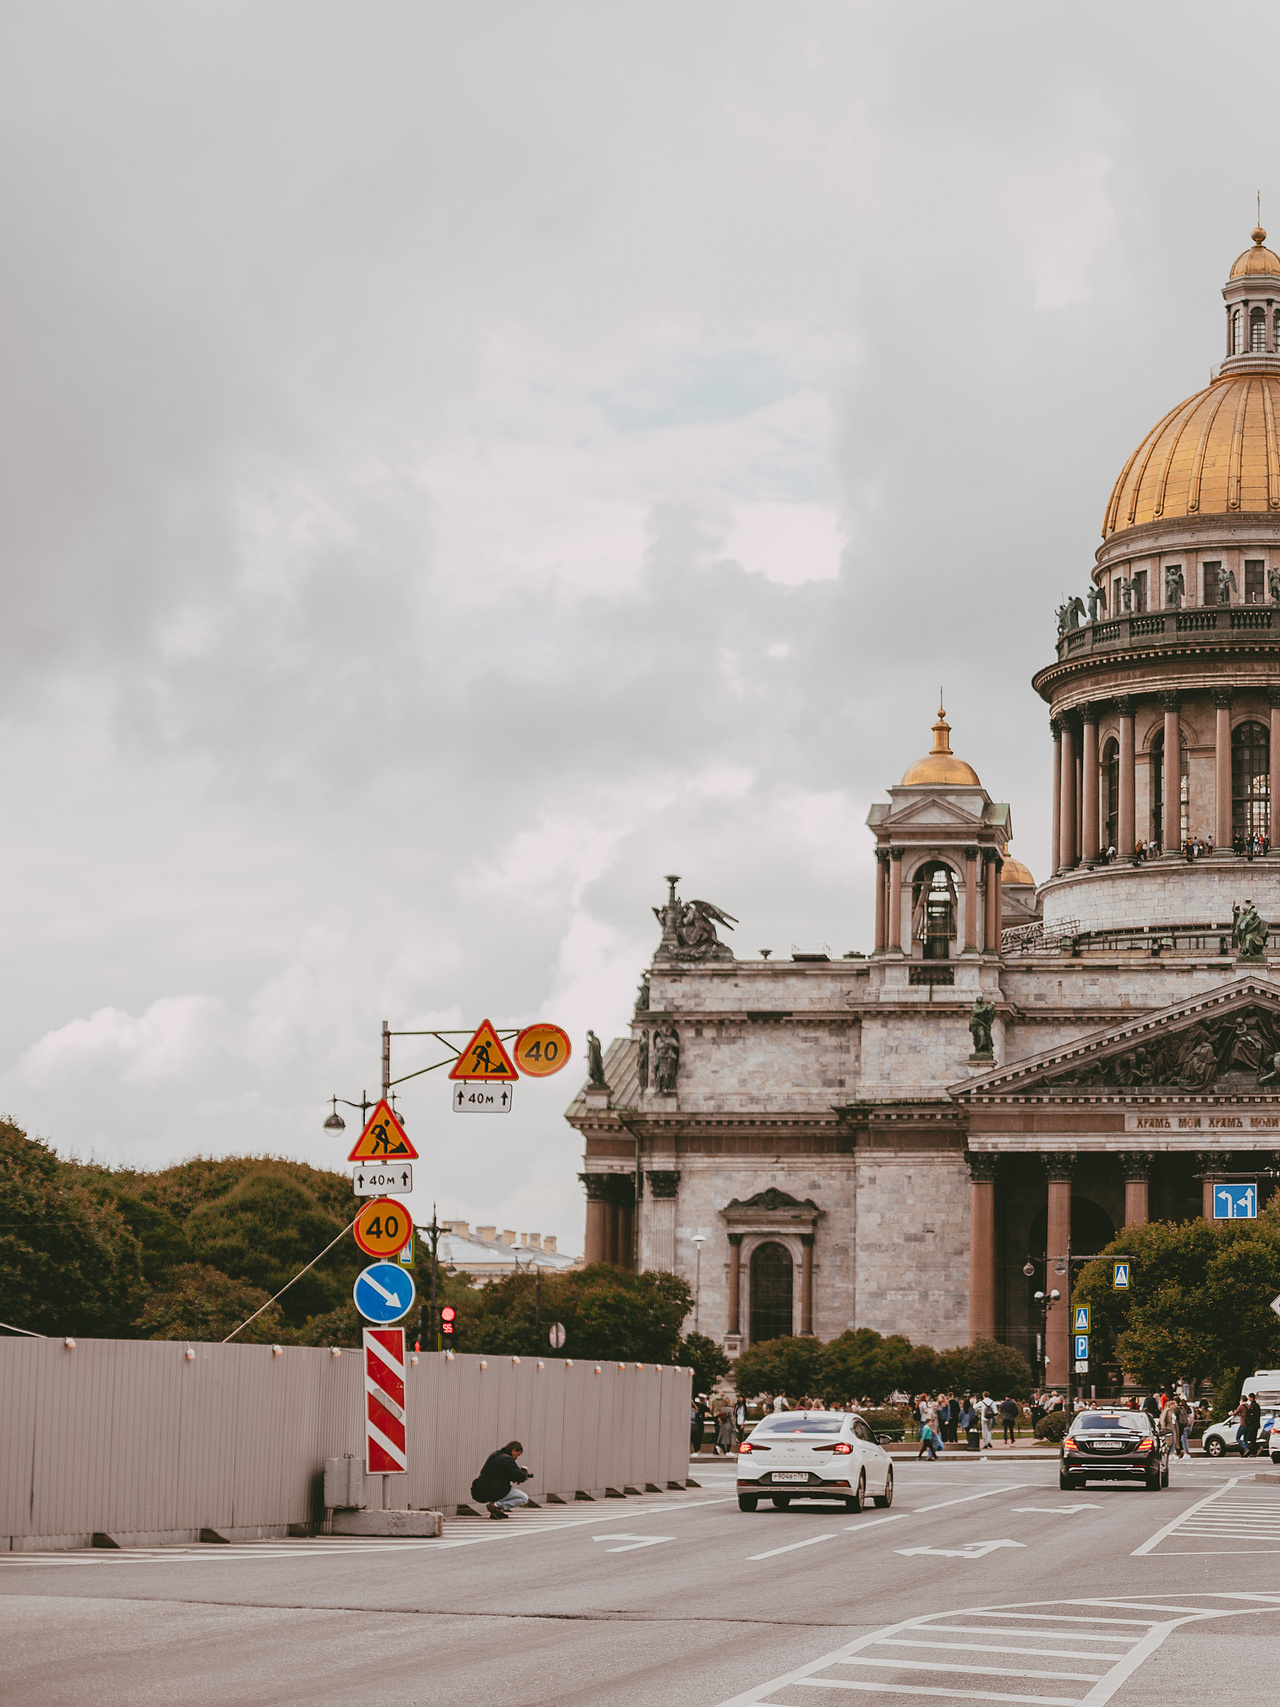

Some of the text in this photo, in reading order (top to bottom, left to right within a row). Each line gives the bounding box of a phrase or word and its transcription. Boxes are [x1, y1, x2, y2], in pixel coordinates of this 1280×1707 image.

[524, 1040, 558, 1062] 40
[365, 1216, 399, 1239] 40
[1078, 1338, 1086, 1356] P
